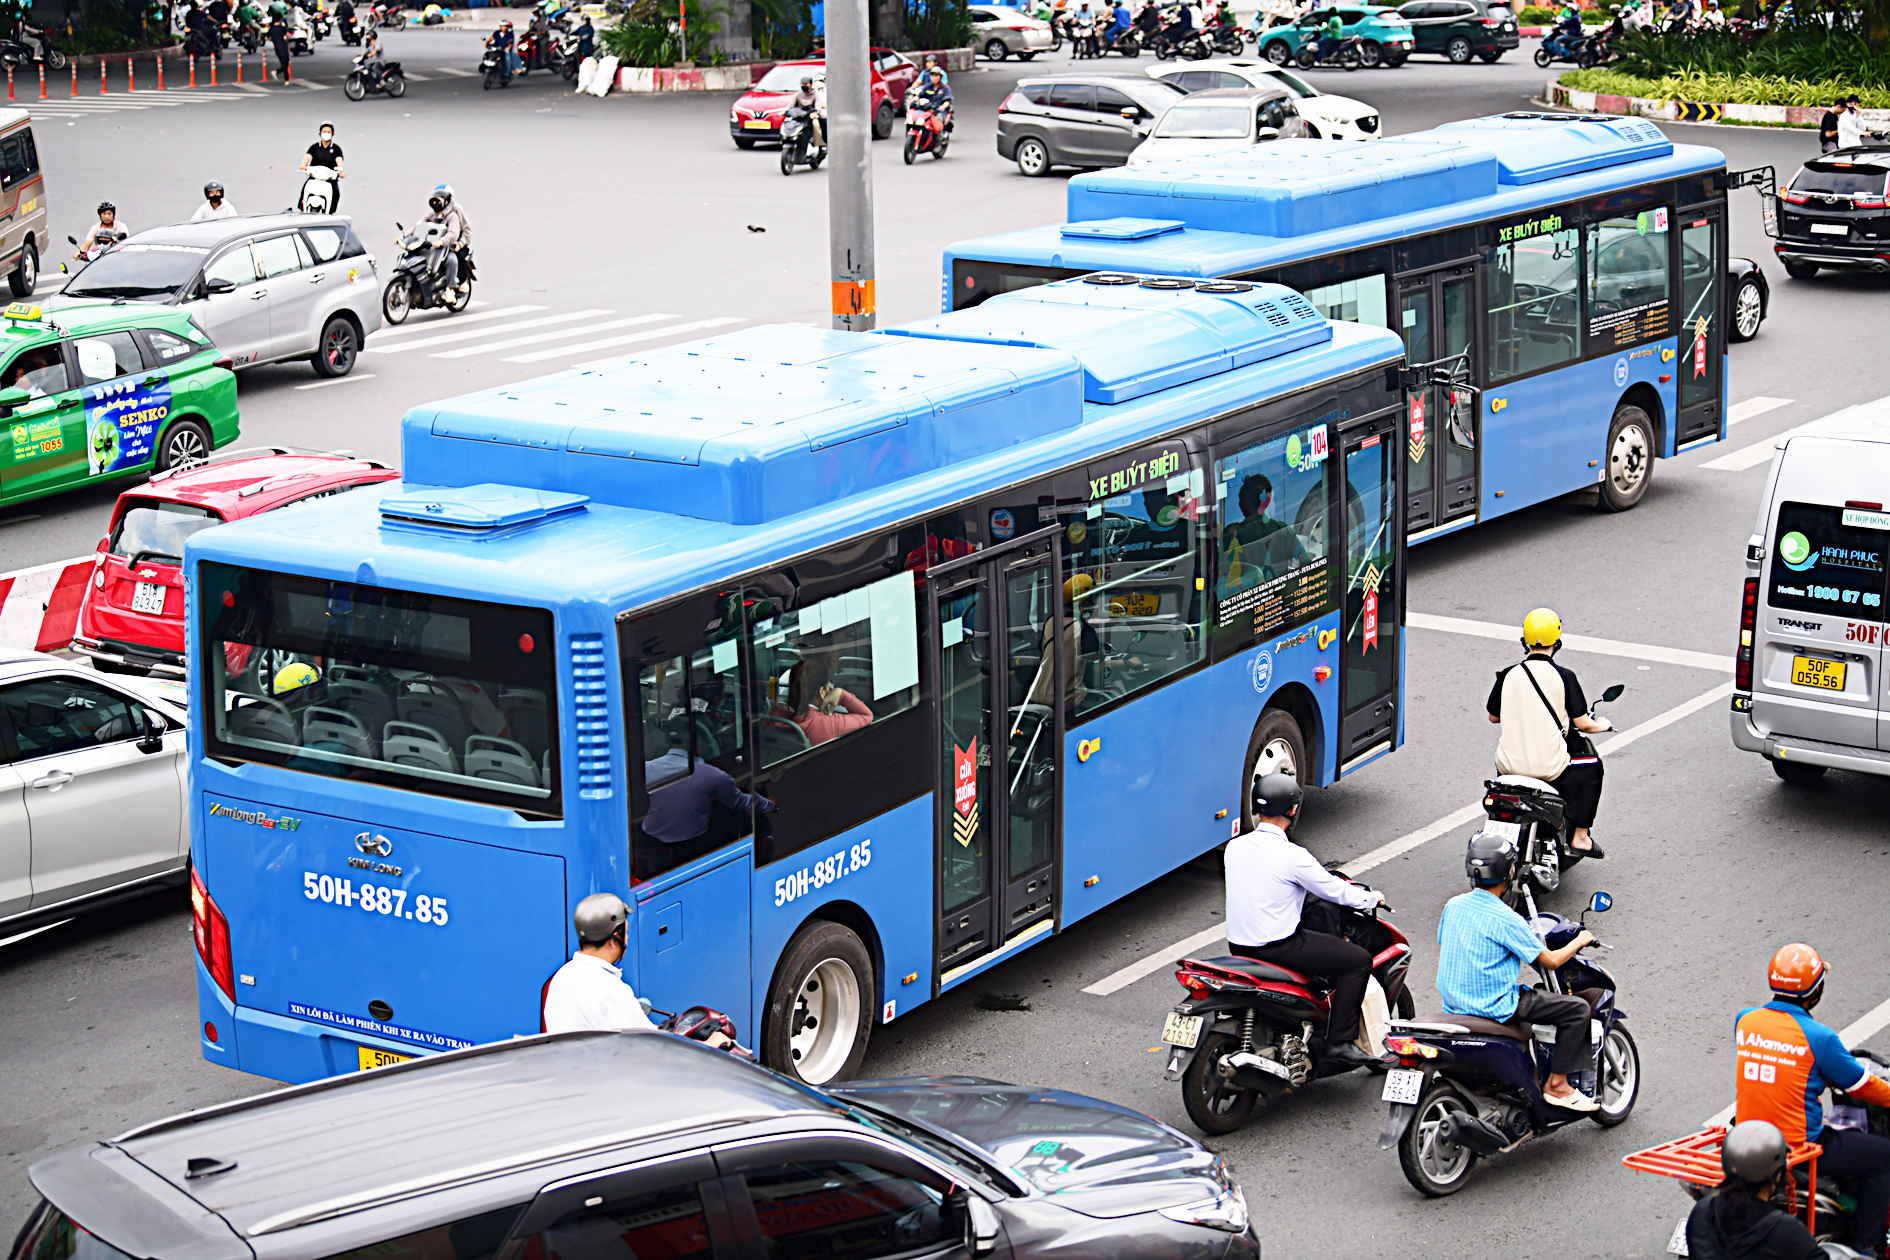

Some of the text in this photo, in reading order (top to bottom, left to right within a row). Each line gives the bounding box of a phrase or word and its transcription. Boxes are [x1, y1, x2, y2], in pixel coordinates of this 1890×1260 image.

[1656, 212, 1667, 229] 104
[1499, 228, 1512, 243] XE
[1513, 220, 1539, 239] BUÝT
[119, 405, 168, 428] SENKO
[40, 437, 63, 453] 1055
[1312, 431, 1327, 455] 104
[1090, 475, 1109, 501] XE
[1111, 460, 1147, 493] BUÝT
[1845, 513, 1854, 523] XE
[1855, 514, 1870, 525] HỢP
[1822, 557, 1877, 569] HOSPITAL
[142, 583, 158, 598] 51A
[1807, 584, 1840, 601] 1900
[1842, 590, 1860, 604] 67
[1862, 592, 1881, 607] 65
[1777, 617, 1823, 631] TRANSIT
[1846, 622, 1880, 644] 50F
[1808, 660, 1830, 673] 50F
[1797, 671, 1838, 688] 055.56
[960, 758, 972, 780] CỬA
[955, 778, 976, 803] XUỐNG
[348, 857, 402, 877] KIM LONG
[774, 838, 871, 907] 50H-887.85
[304, 871, 449, 926] 50H-887.85
[290, 1004, 306, 1015] XIN
[322, 1011, 335, 1022] ĐÃ
[335, 1014, 355, 1026] LÀM
[383, 1024, 398, 1036] KHI
[400, 1029, 412, 1038] XE
[413, 1031, 425, 1042] RA
[426, 1033, 445, 1045] VÀO
[1172, 1016, 1196, 1030] 43-C1
[1164, 1029, 1196, 1046] 219.78
[1745, 1032, 1806, 1056] Ahamove
[1391, 1071, 1416, 1086] 59-X1
